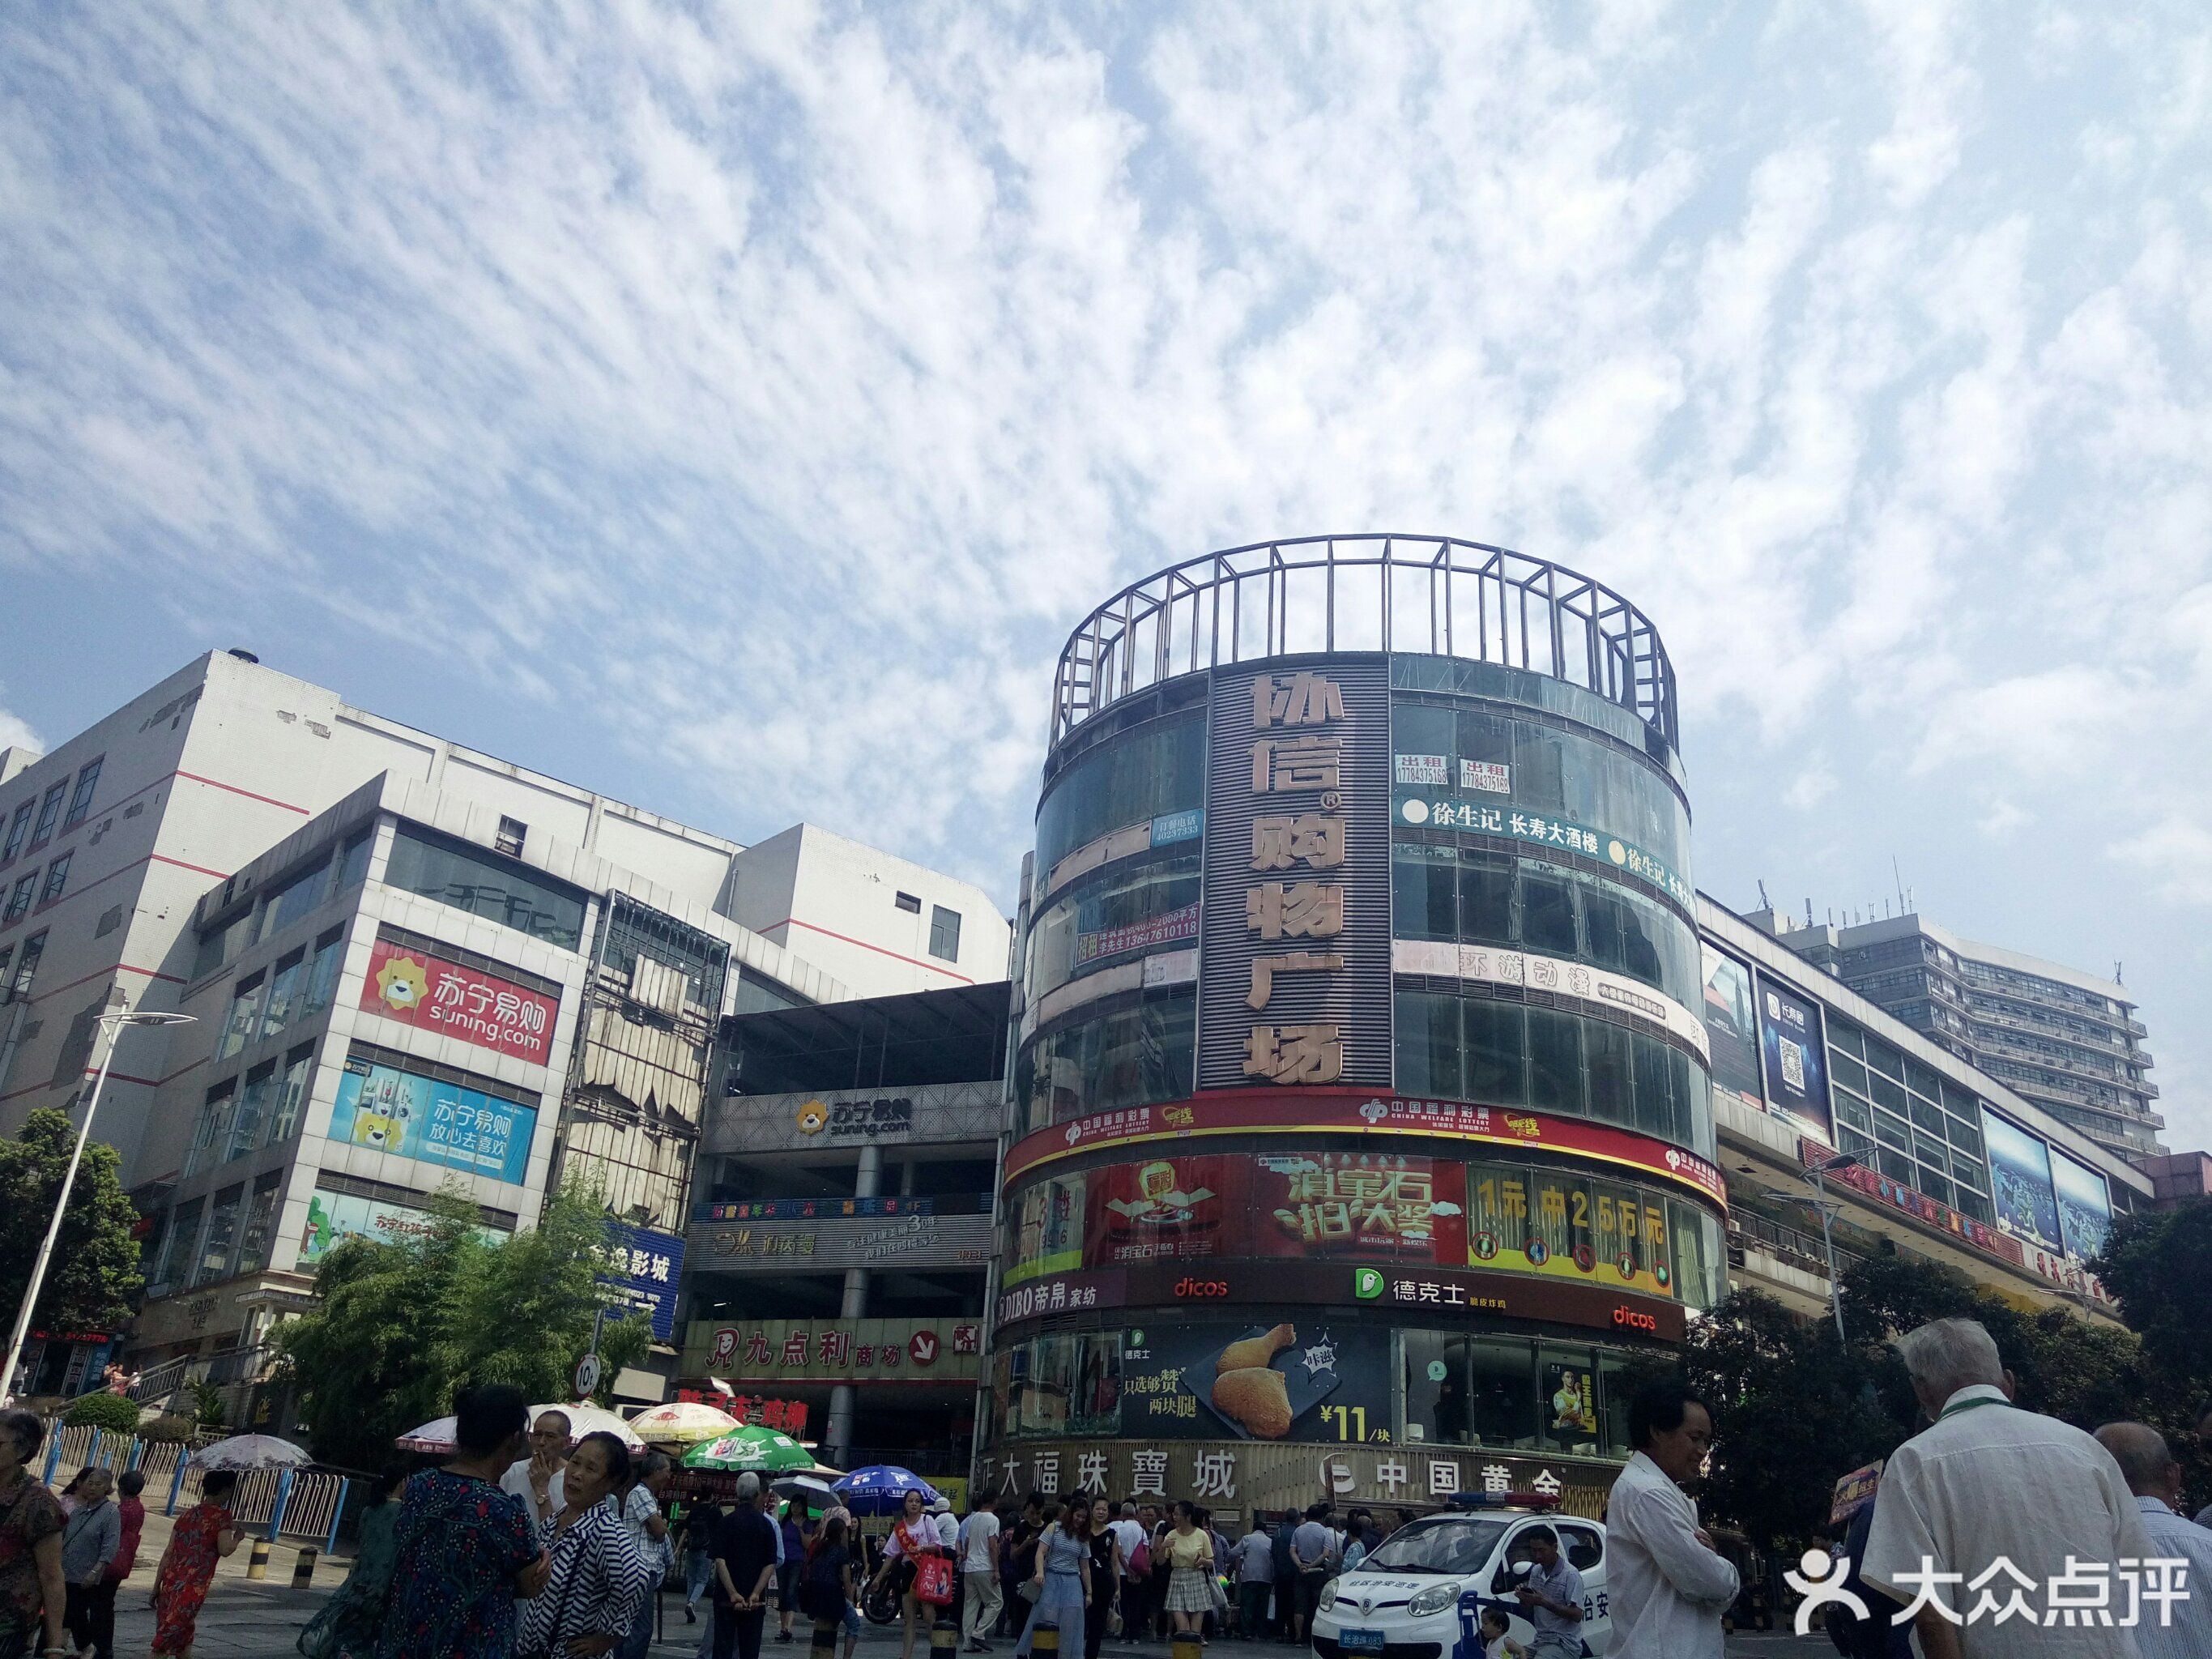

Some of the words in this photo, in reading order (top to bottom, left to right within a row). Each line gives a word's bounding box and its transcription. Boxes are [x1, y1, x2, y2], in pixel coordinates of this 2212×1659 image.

[1402, 757, 1443, 768] 出租
[1467, 761, 1505, 776] 出租
[1431, 801, 1502, 832] 徐生记
[1509, 813, 1599, 855] 长寿大酒楼
[1243, 672, 1345, 1085] 协信购物广场
[1626, 848, 1666, 886] 徐生记
[1078, 933, 1097, 962] 招租
[433, 973, 546, 1034] 苏宁易购
[429, 1005, 541, 1051] suning.com
[433, 1098, 512, 1138] 苏宁易购
[1392, 1101, 1490, 1120] 中国福利彩票
[1459, 1118, 1490, 1126] LOTTERY
[428, 1123, 507, 1157] 放心去喜欢
[1174, 1277, 1229, 1297] dicos
[1392, 1280, 1465, 1305] 德克士
[1004, 1287, 1032, 1323] DIBO
[1070, 1286, 1097, 1308] 家纺
[1614, 1305, 1656, 1330] dicos
[1125, 1350, 1150, 1360] 德克士
[578, 1365, 594, 1388] 10t
[1149, 1395, 1197, 1418] 两块腿
[1377, 1457, 1562, 1497] 中国黄金
